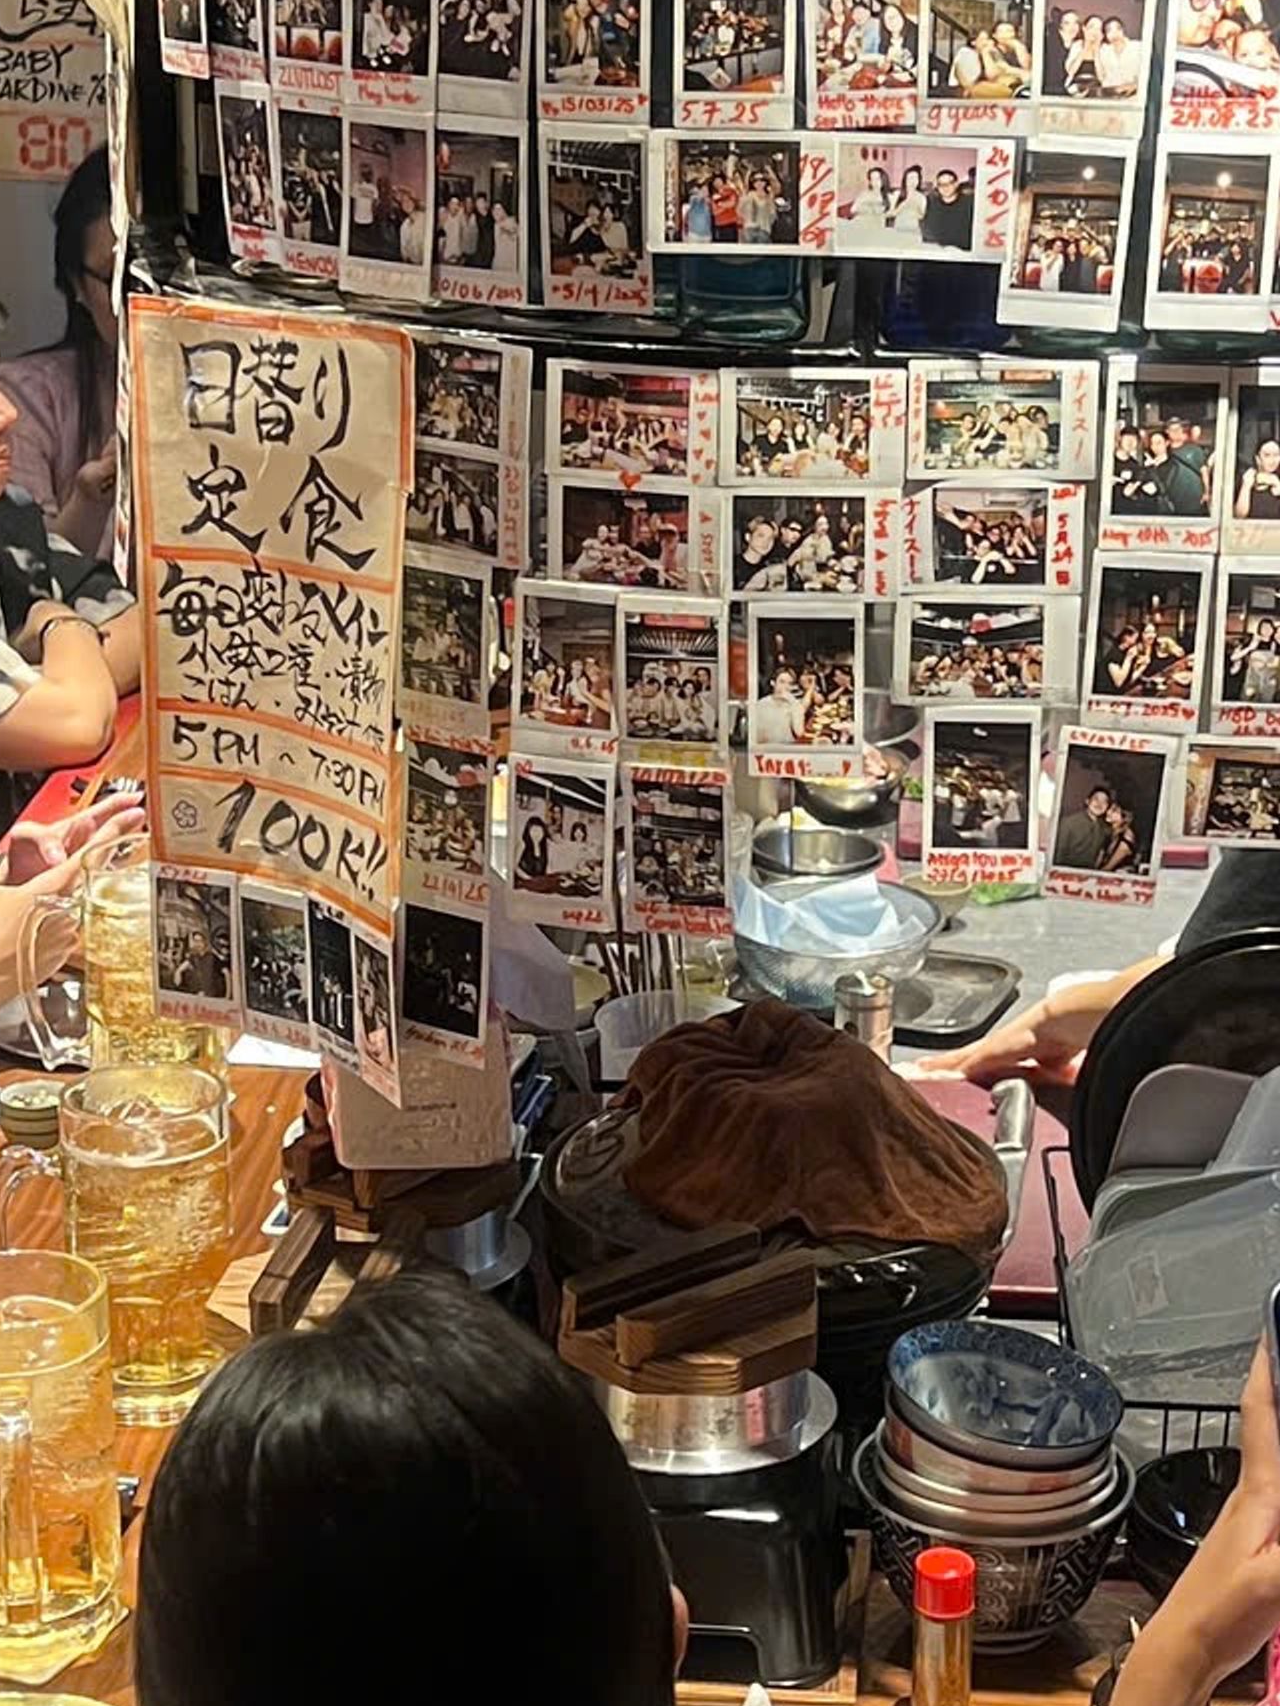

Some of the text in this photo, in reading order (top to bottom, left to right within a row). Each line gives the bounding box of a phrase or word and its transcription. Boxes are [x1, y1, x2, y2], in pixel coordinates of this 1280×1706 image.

[180, 335, 349, 453] 日替り
[180, 443, 377, 572] 定食
